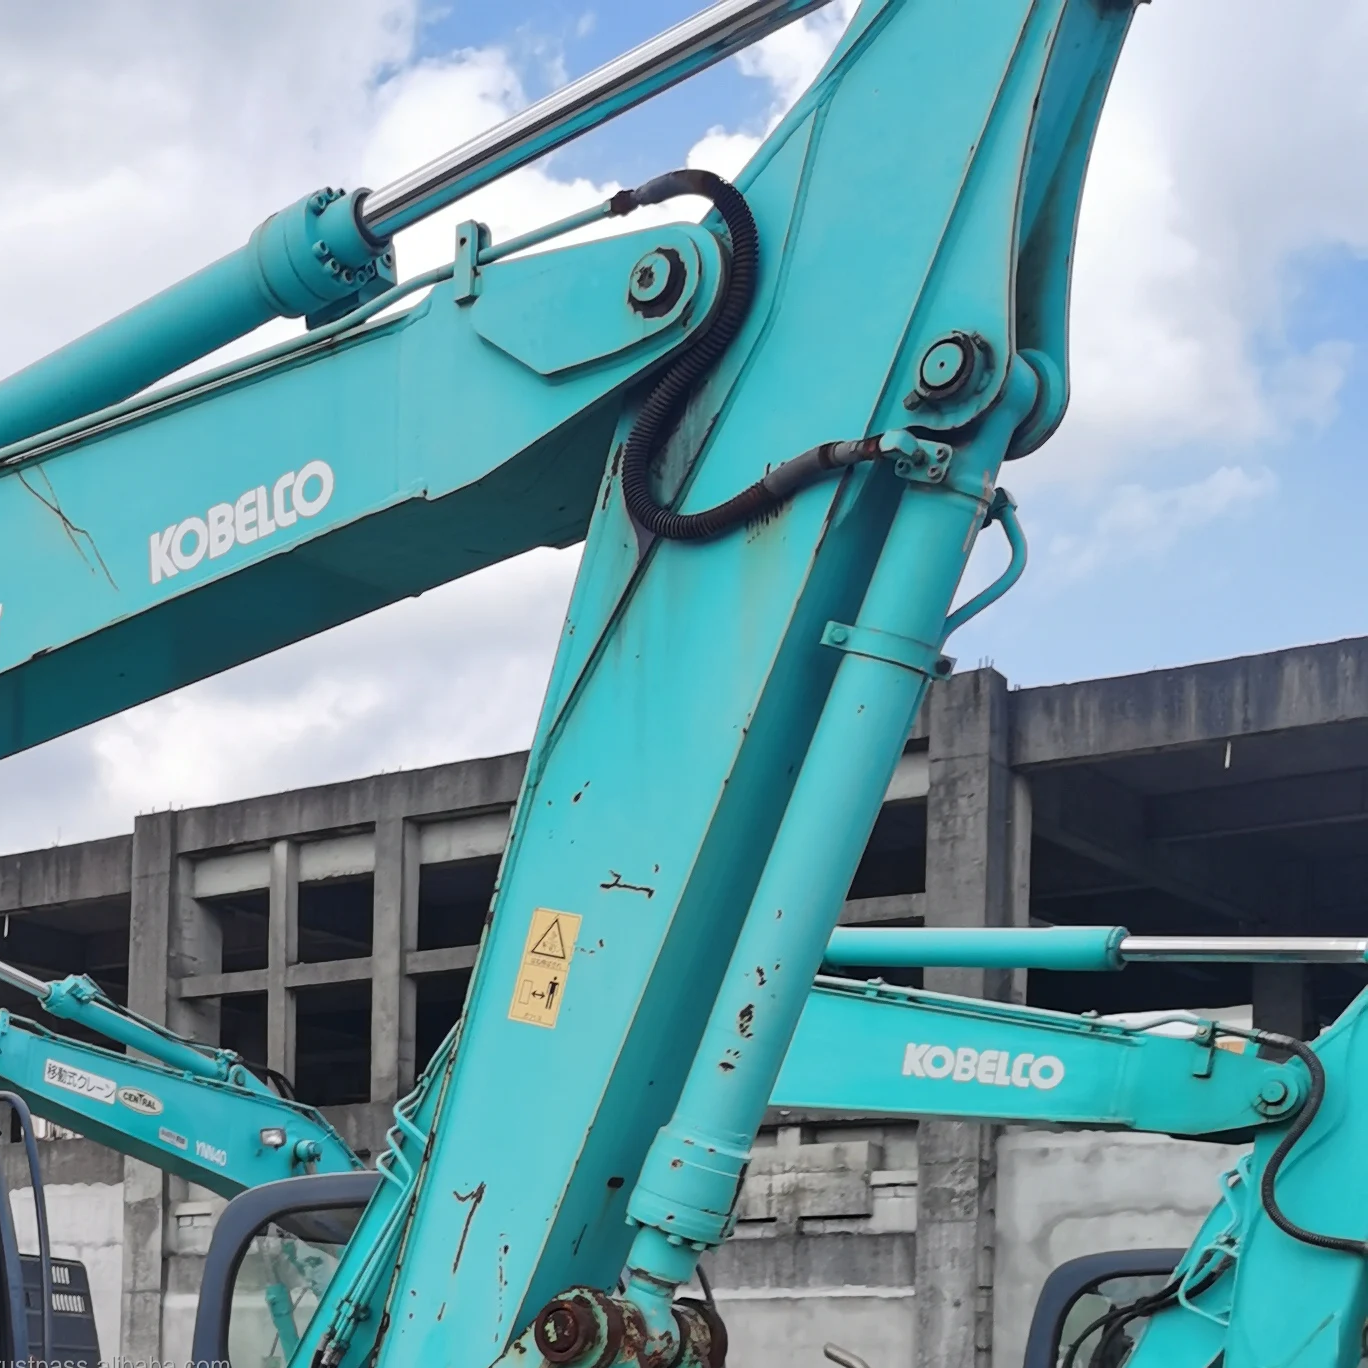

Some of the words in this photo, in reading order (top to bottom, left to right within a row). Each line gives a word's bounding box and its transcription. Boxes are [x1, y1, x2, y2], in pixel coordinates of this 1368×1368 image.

[150, 460, 334, 584] KOBELCO
[902, 1041, 1065, 1090] KOBELCO
[122, 1091, 157, 1111] CENTRAL
